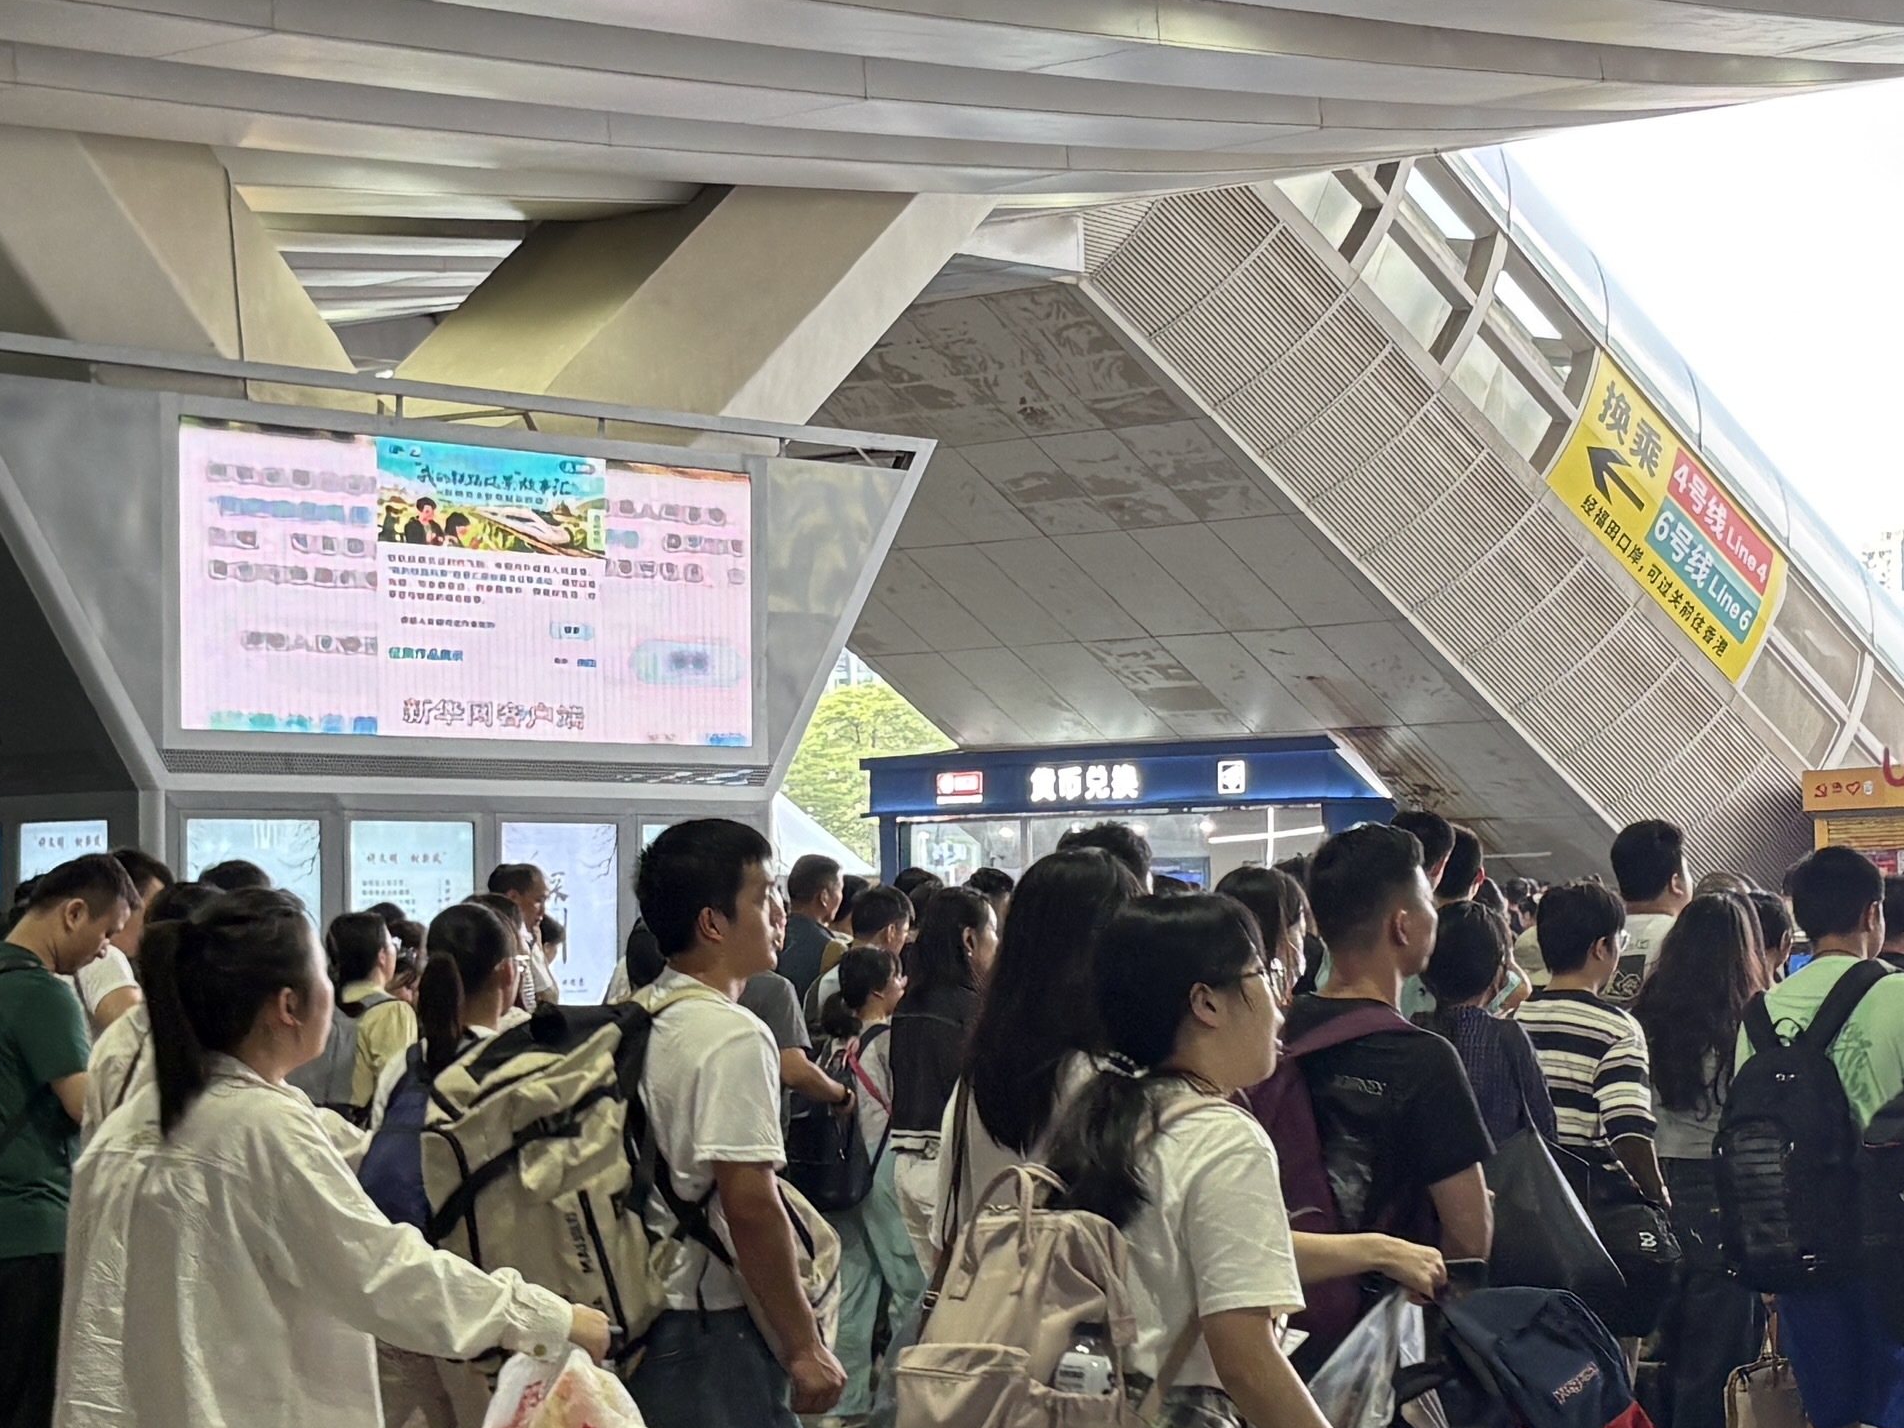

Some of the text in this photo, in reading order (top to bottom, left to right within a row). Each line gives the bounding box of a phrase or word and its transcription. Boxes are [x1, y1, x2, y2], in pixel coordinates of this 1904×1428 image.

[1598, 380, 1664, 477] 换乘
[1653, 510, 1750, 632] 6号线 Line 6
[1673, 463, 1768, 584] 4号线 Line 4
[402, 697, 585, 731] 新华网客户端
[1030, 763, 1140, 802] 货币兑换
